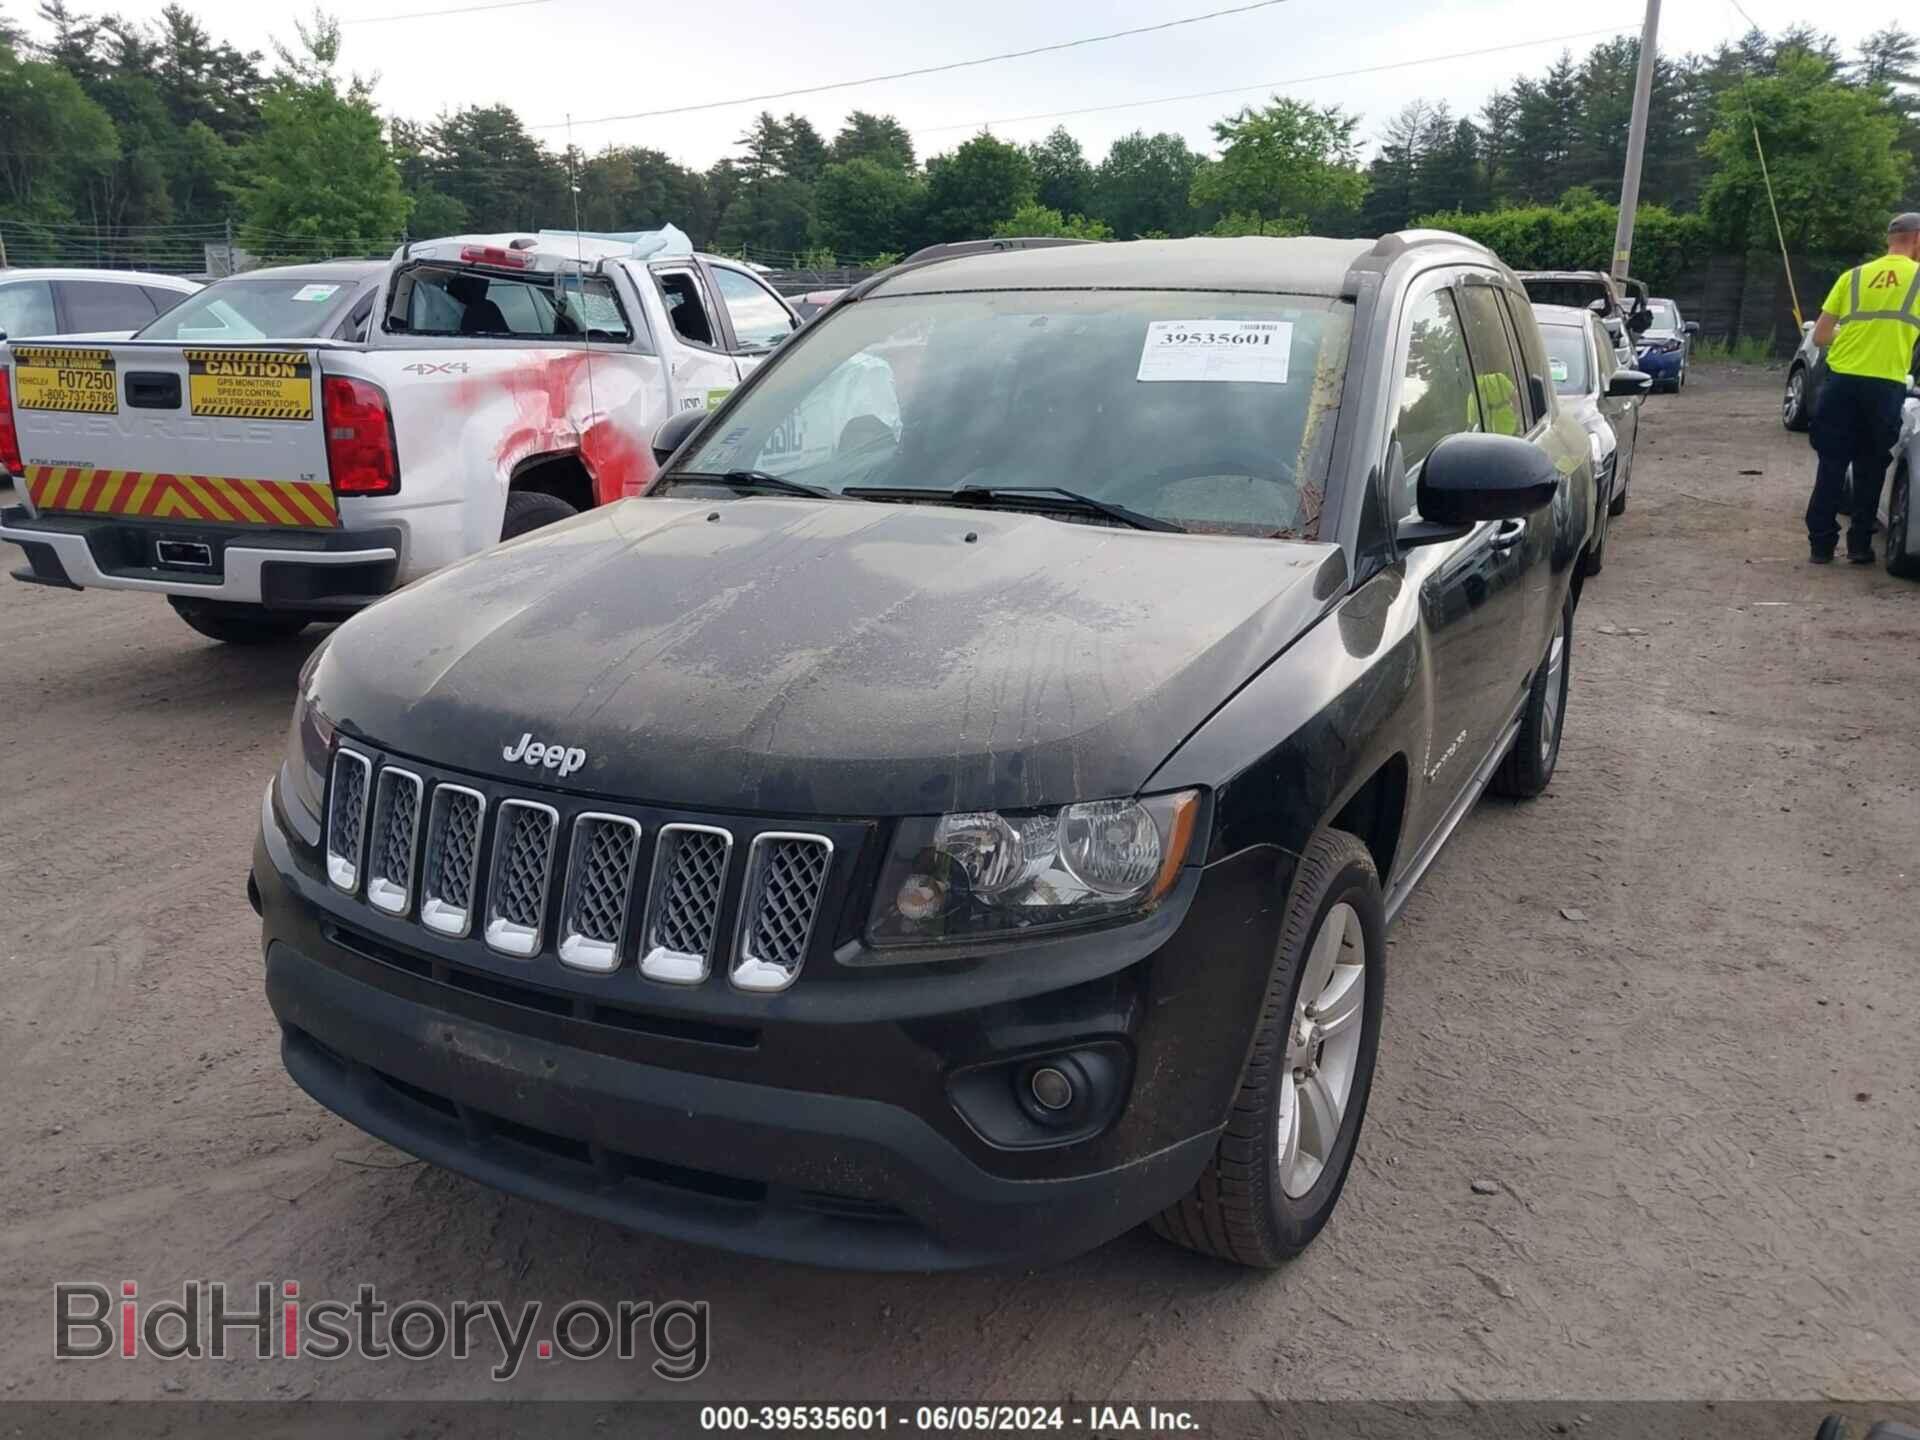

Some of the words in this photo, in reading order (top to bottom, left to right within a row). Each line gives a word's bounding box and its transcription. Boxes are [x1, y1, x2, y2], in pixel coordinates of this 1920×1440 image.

[1160, 332, 1272, 345] 39535601
[205, 361, 296, 377] CAUTION
[58, 370, 113, 390] F07250
[217, 378, 234, 386] GPS
[235, 378, 282, 388] MONITORED
[39, 388, 114, 404] 1-800-737-6789
[217, 387, 243, 397] SPEED
[245, 388, 282, 398] CONTROL
[201, 396, 228, 406] MAKES
[230, 397, 271, 407] FREQUENT
[273, 399, 301, 409] STOPS
[503, 733, 586, 777] Jeep
